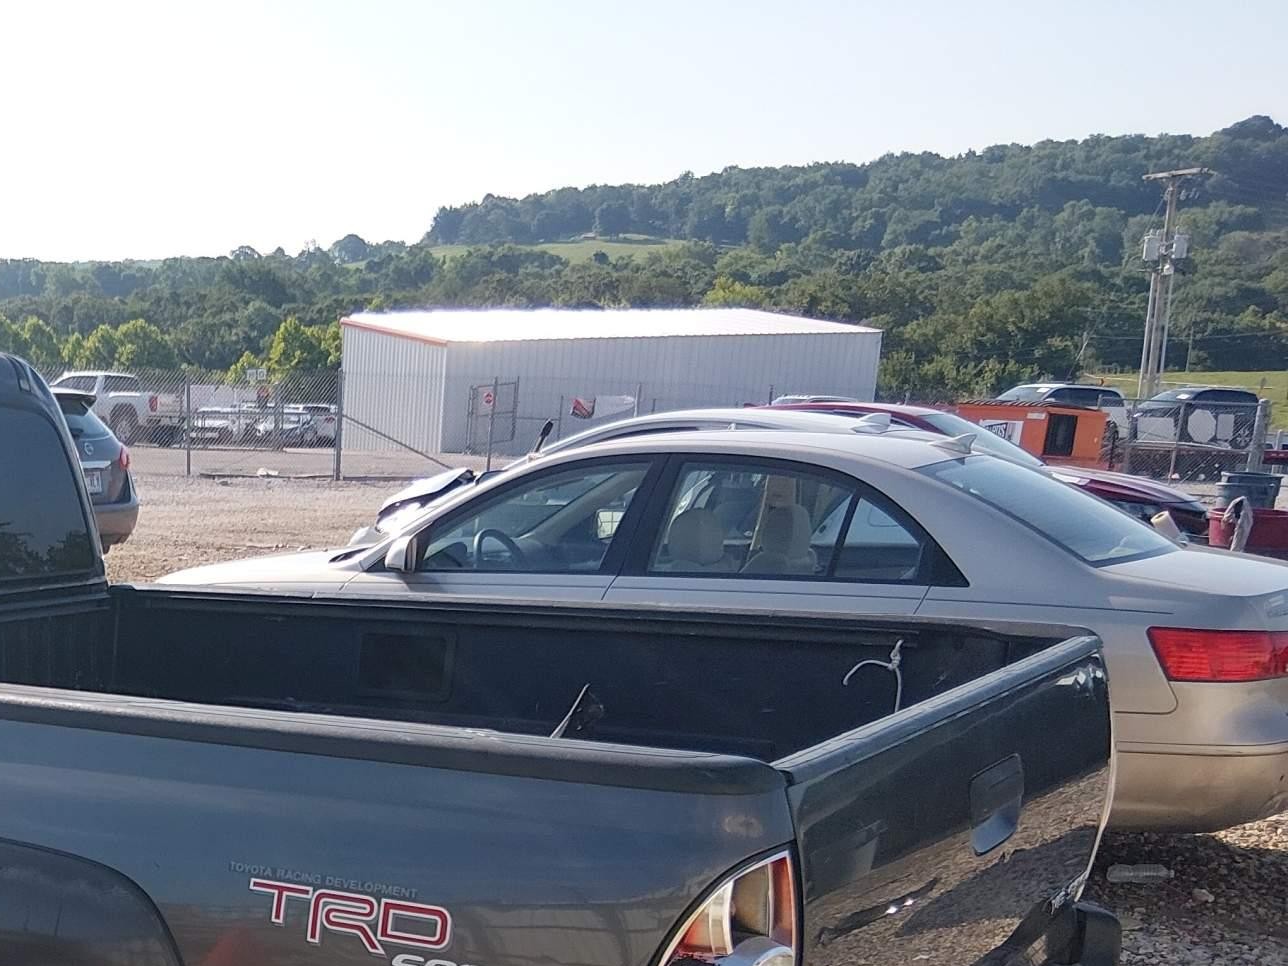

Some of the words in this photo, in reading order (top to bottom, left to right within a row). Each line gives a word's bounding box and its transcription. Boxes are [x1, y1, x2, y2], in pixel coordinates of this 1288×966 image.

[230, 861, 272, 877] TOYOTA
[277, 869, 321, 885] RACING
[325, 876, 418, 899] DEVELOPMENT
[249, 877, 452, 957] TRD
